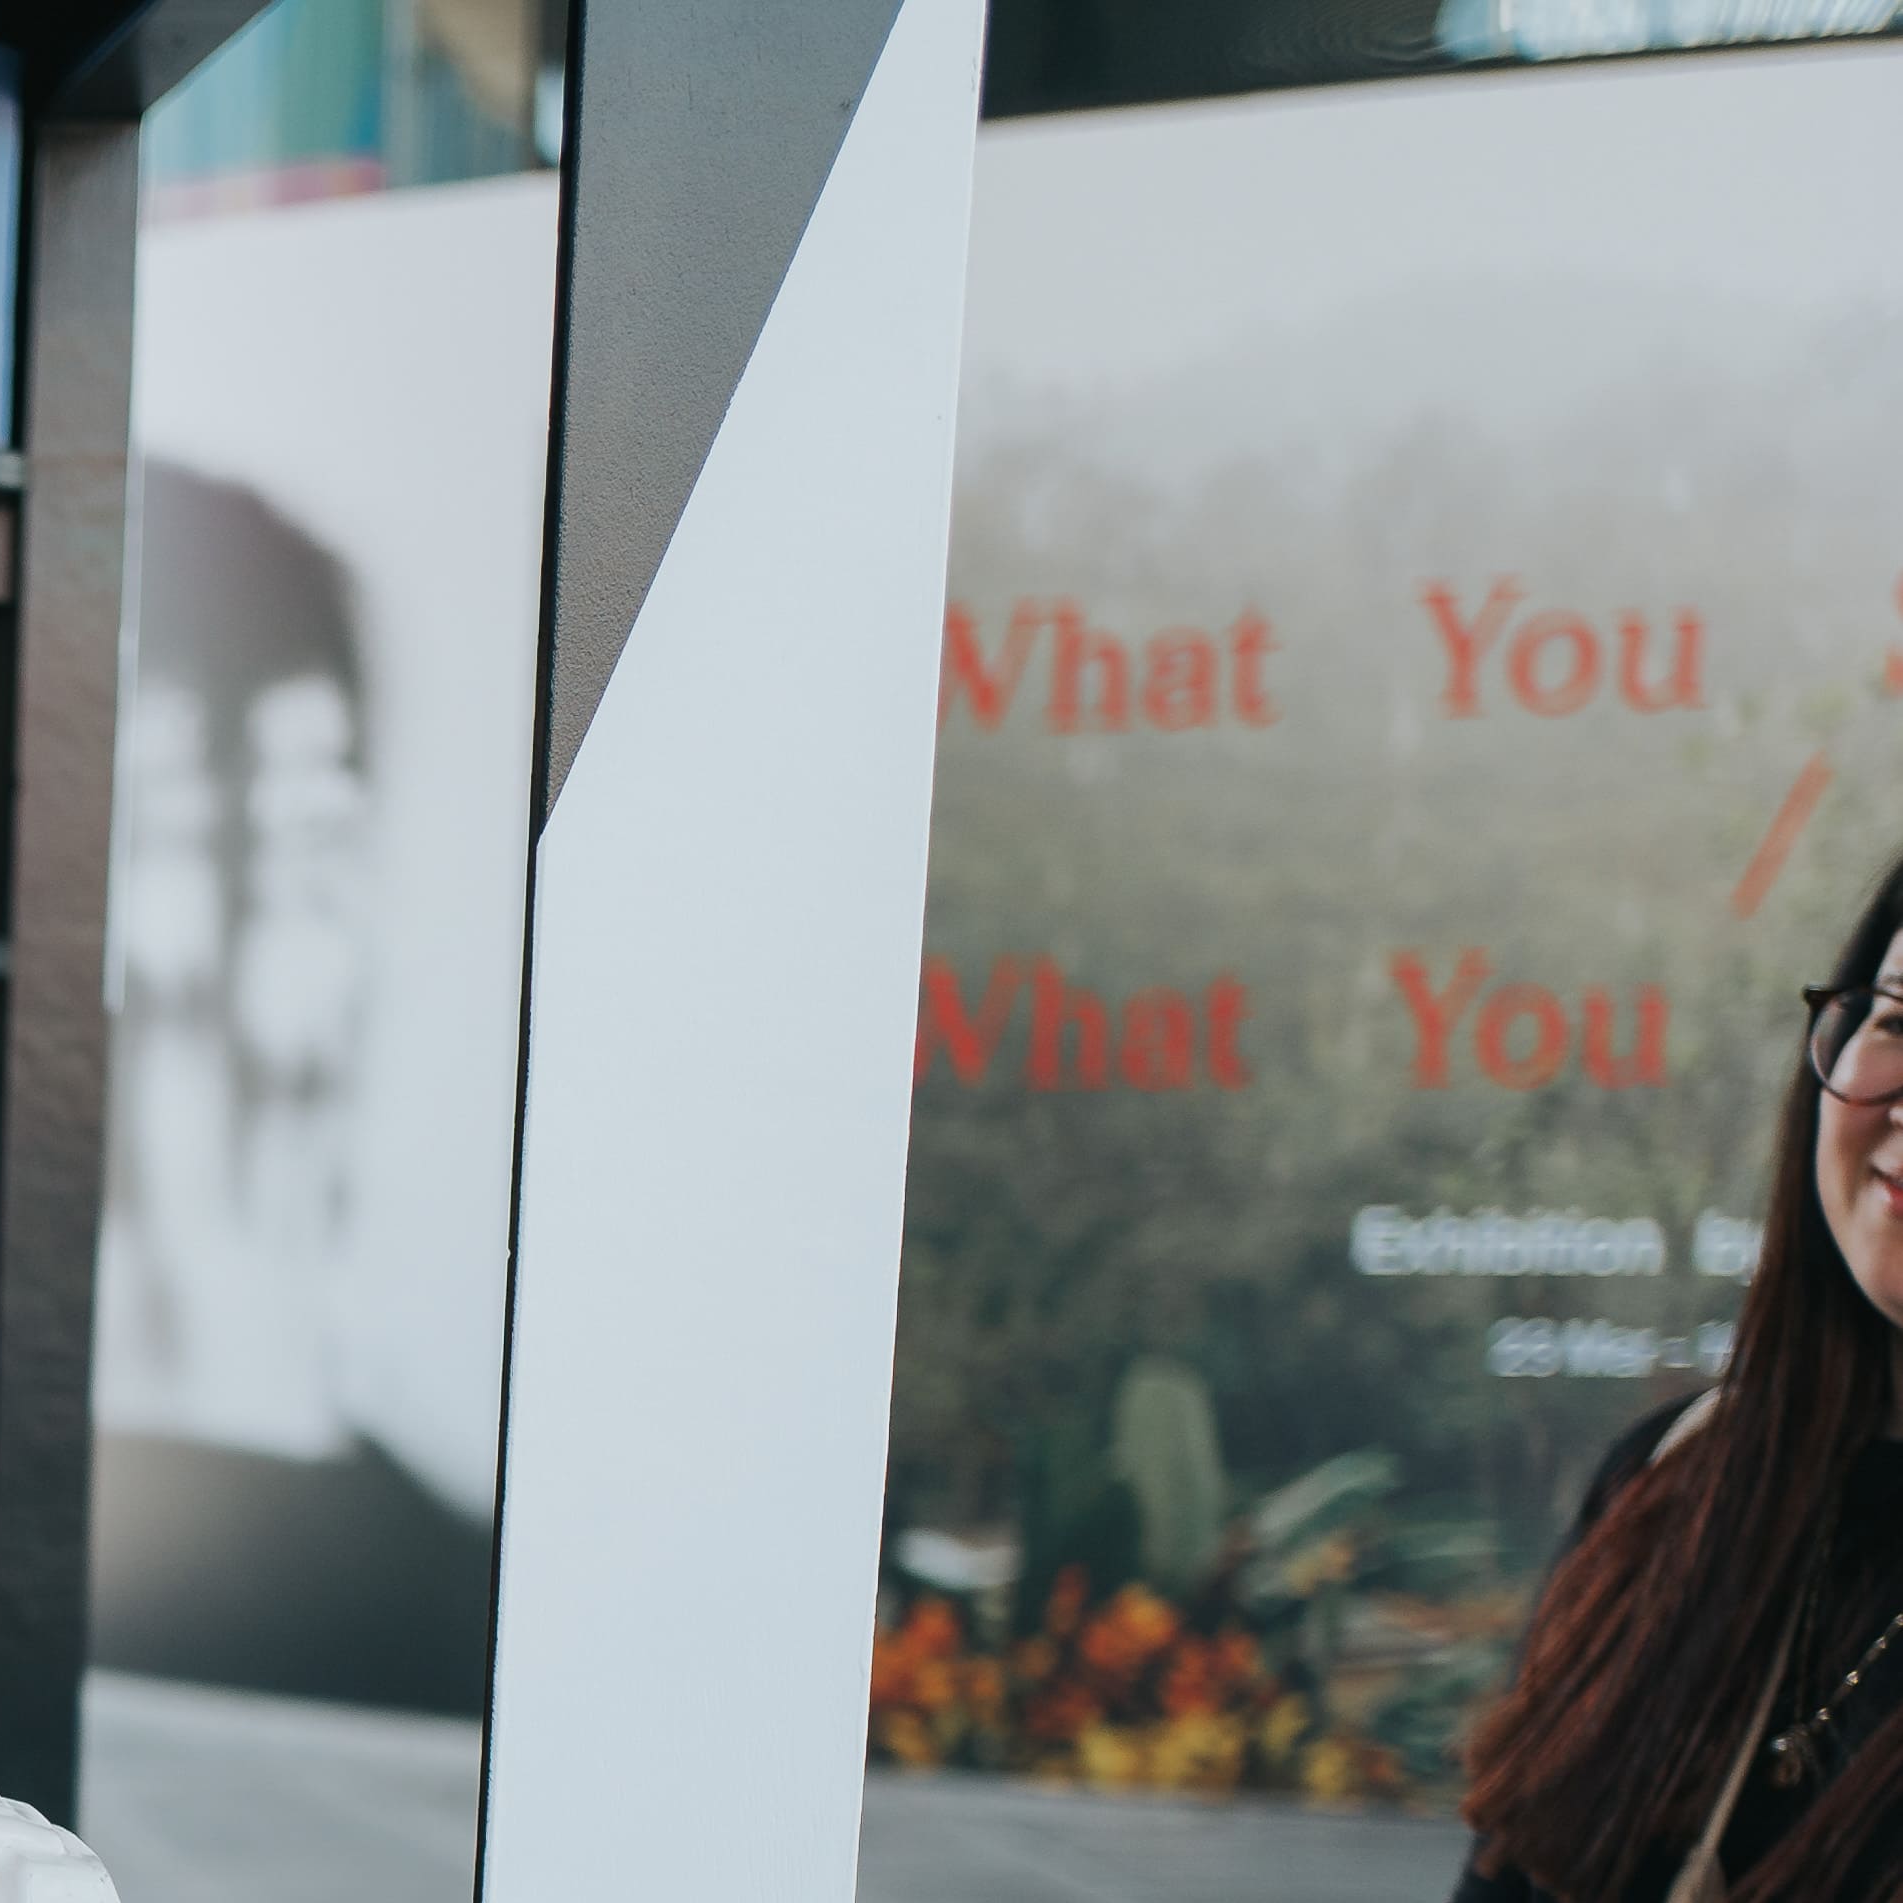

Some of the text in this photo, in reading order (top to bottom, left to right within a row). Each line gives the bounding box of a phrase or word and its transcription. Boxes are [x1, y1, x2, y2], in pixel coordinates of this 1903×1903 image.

[1417, 573, 1709, 721] You
[1387, 945, 1672, 1092] You
[1351, 1203, 1669, 1279] Exhibition
